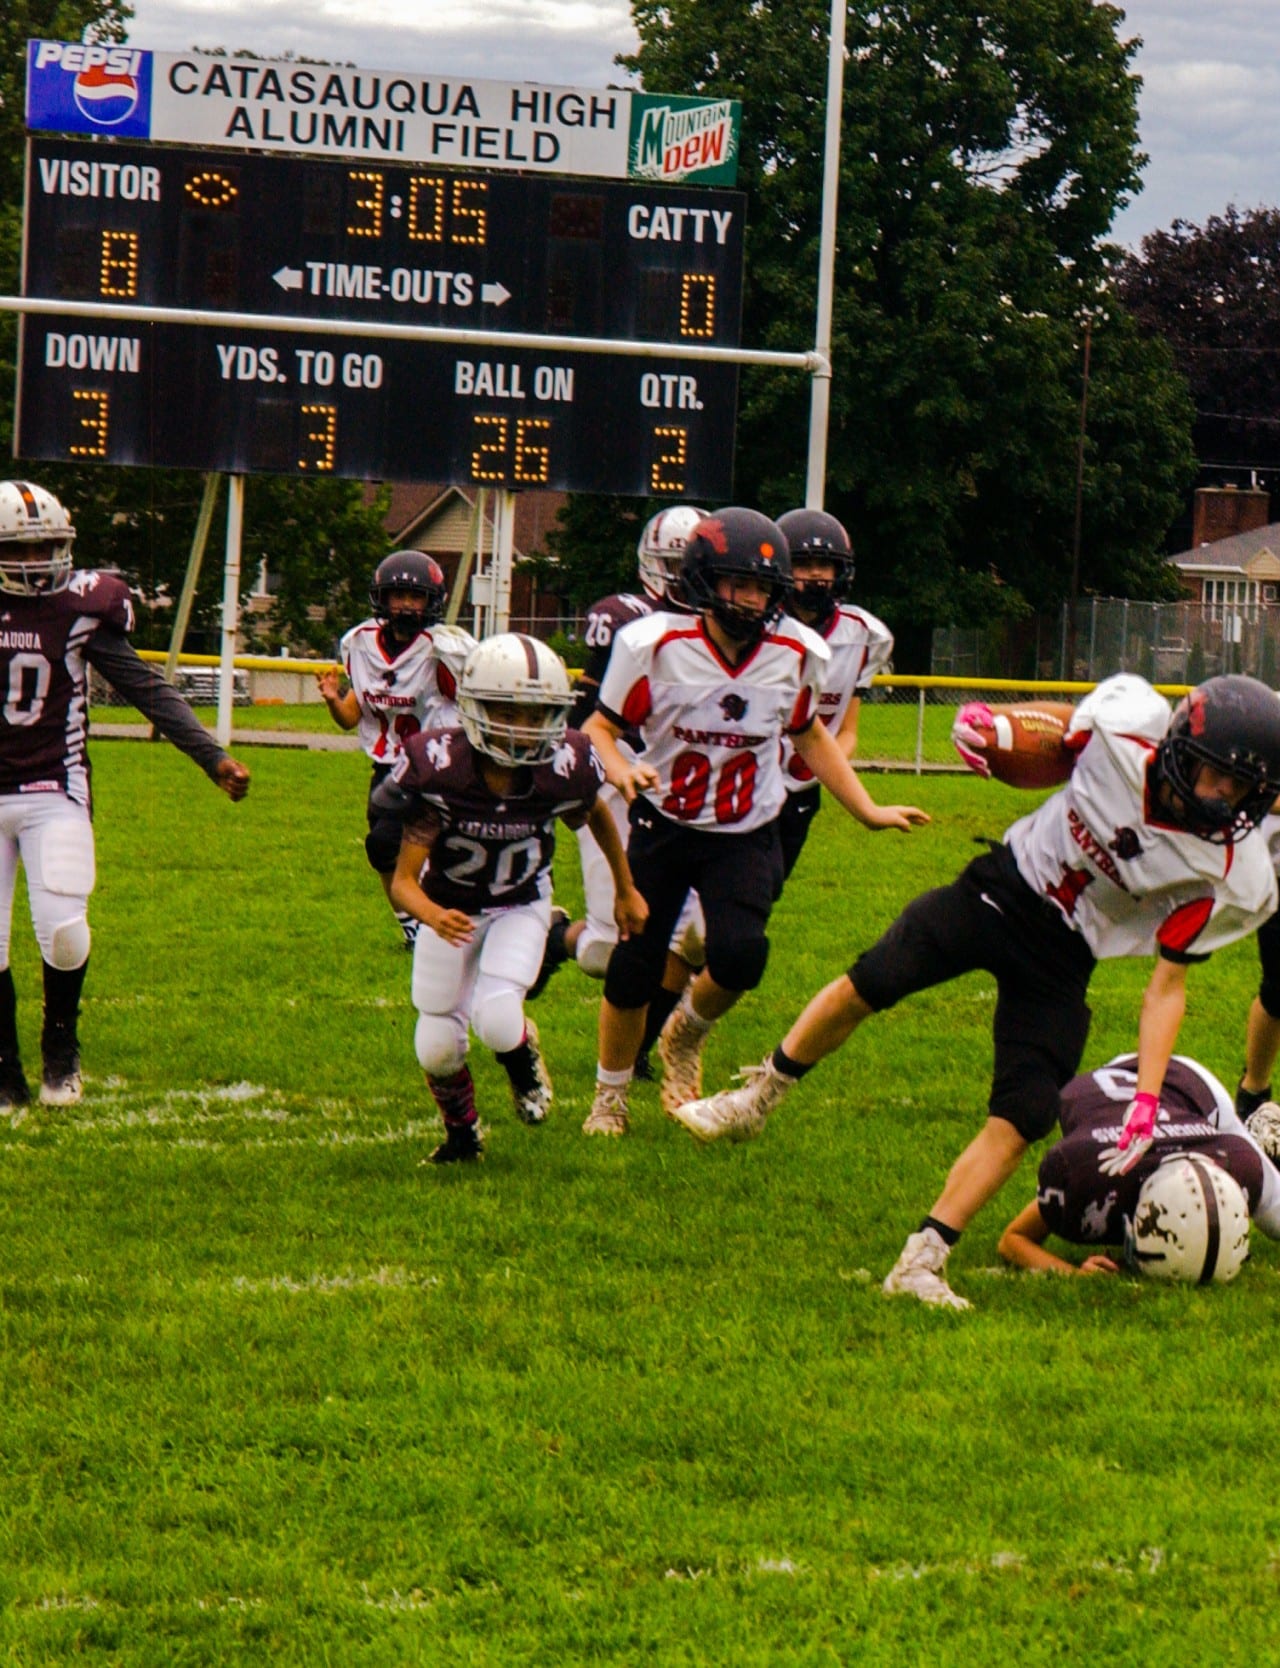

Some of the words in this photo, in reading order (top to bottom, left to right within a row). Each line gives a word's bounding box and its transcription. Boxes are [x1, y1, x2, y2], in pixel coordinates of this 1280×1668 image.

[35, 43, 142, 76] PEPSI
[168, 60, 481, 119] CATASAUQUA
[511, 89, 617, 129] HIGH
[225, 106, 404, 152] ALUMNI
[431, 122, 560, 163] FIELD
[39, 158, 161, 202] VISITOR
[347, 171, 488, 245] 3:05
[627, 204, 733, 245] CATTY
[100, 230, 138, 297] 8
[306, 261, 474, 307] TIME-OUTS
[679, 273, 716, 337] 0
[45, 332, 140, 373] DOWN
[216, 345, 287, 384] YDS.
[295, 349, 335, 386] TO
[342, 353, 383, 389] GO
[454, 360, 526, 398] BALL
[534, 366, 575, 402] ON
[639, 372, 705, 411] QTR.
[69, 390, 108, 456] 3
[298, 404, 337, 471] 3
[471, 415, 551, 482] 26
[651, 426, 687, 491] 2
[443, 836, 542, 897] 20
